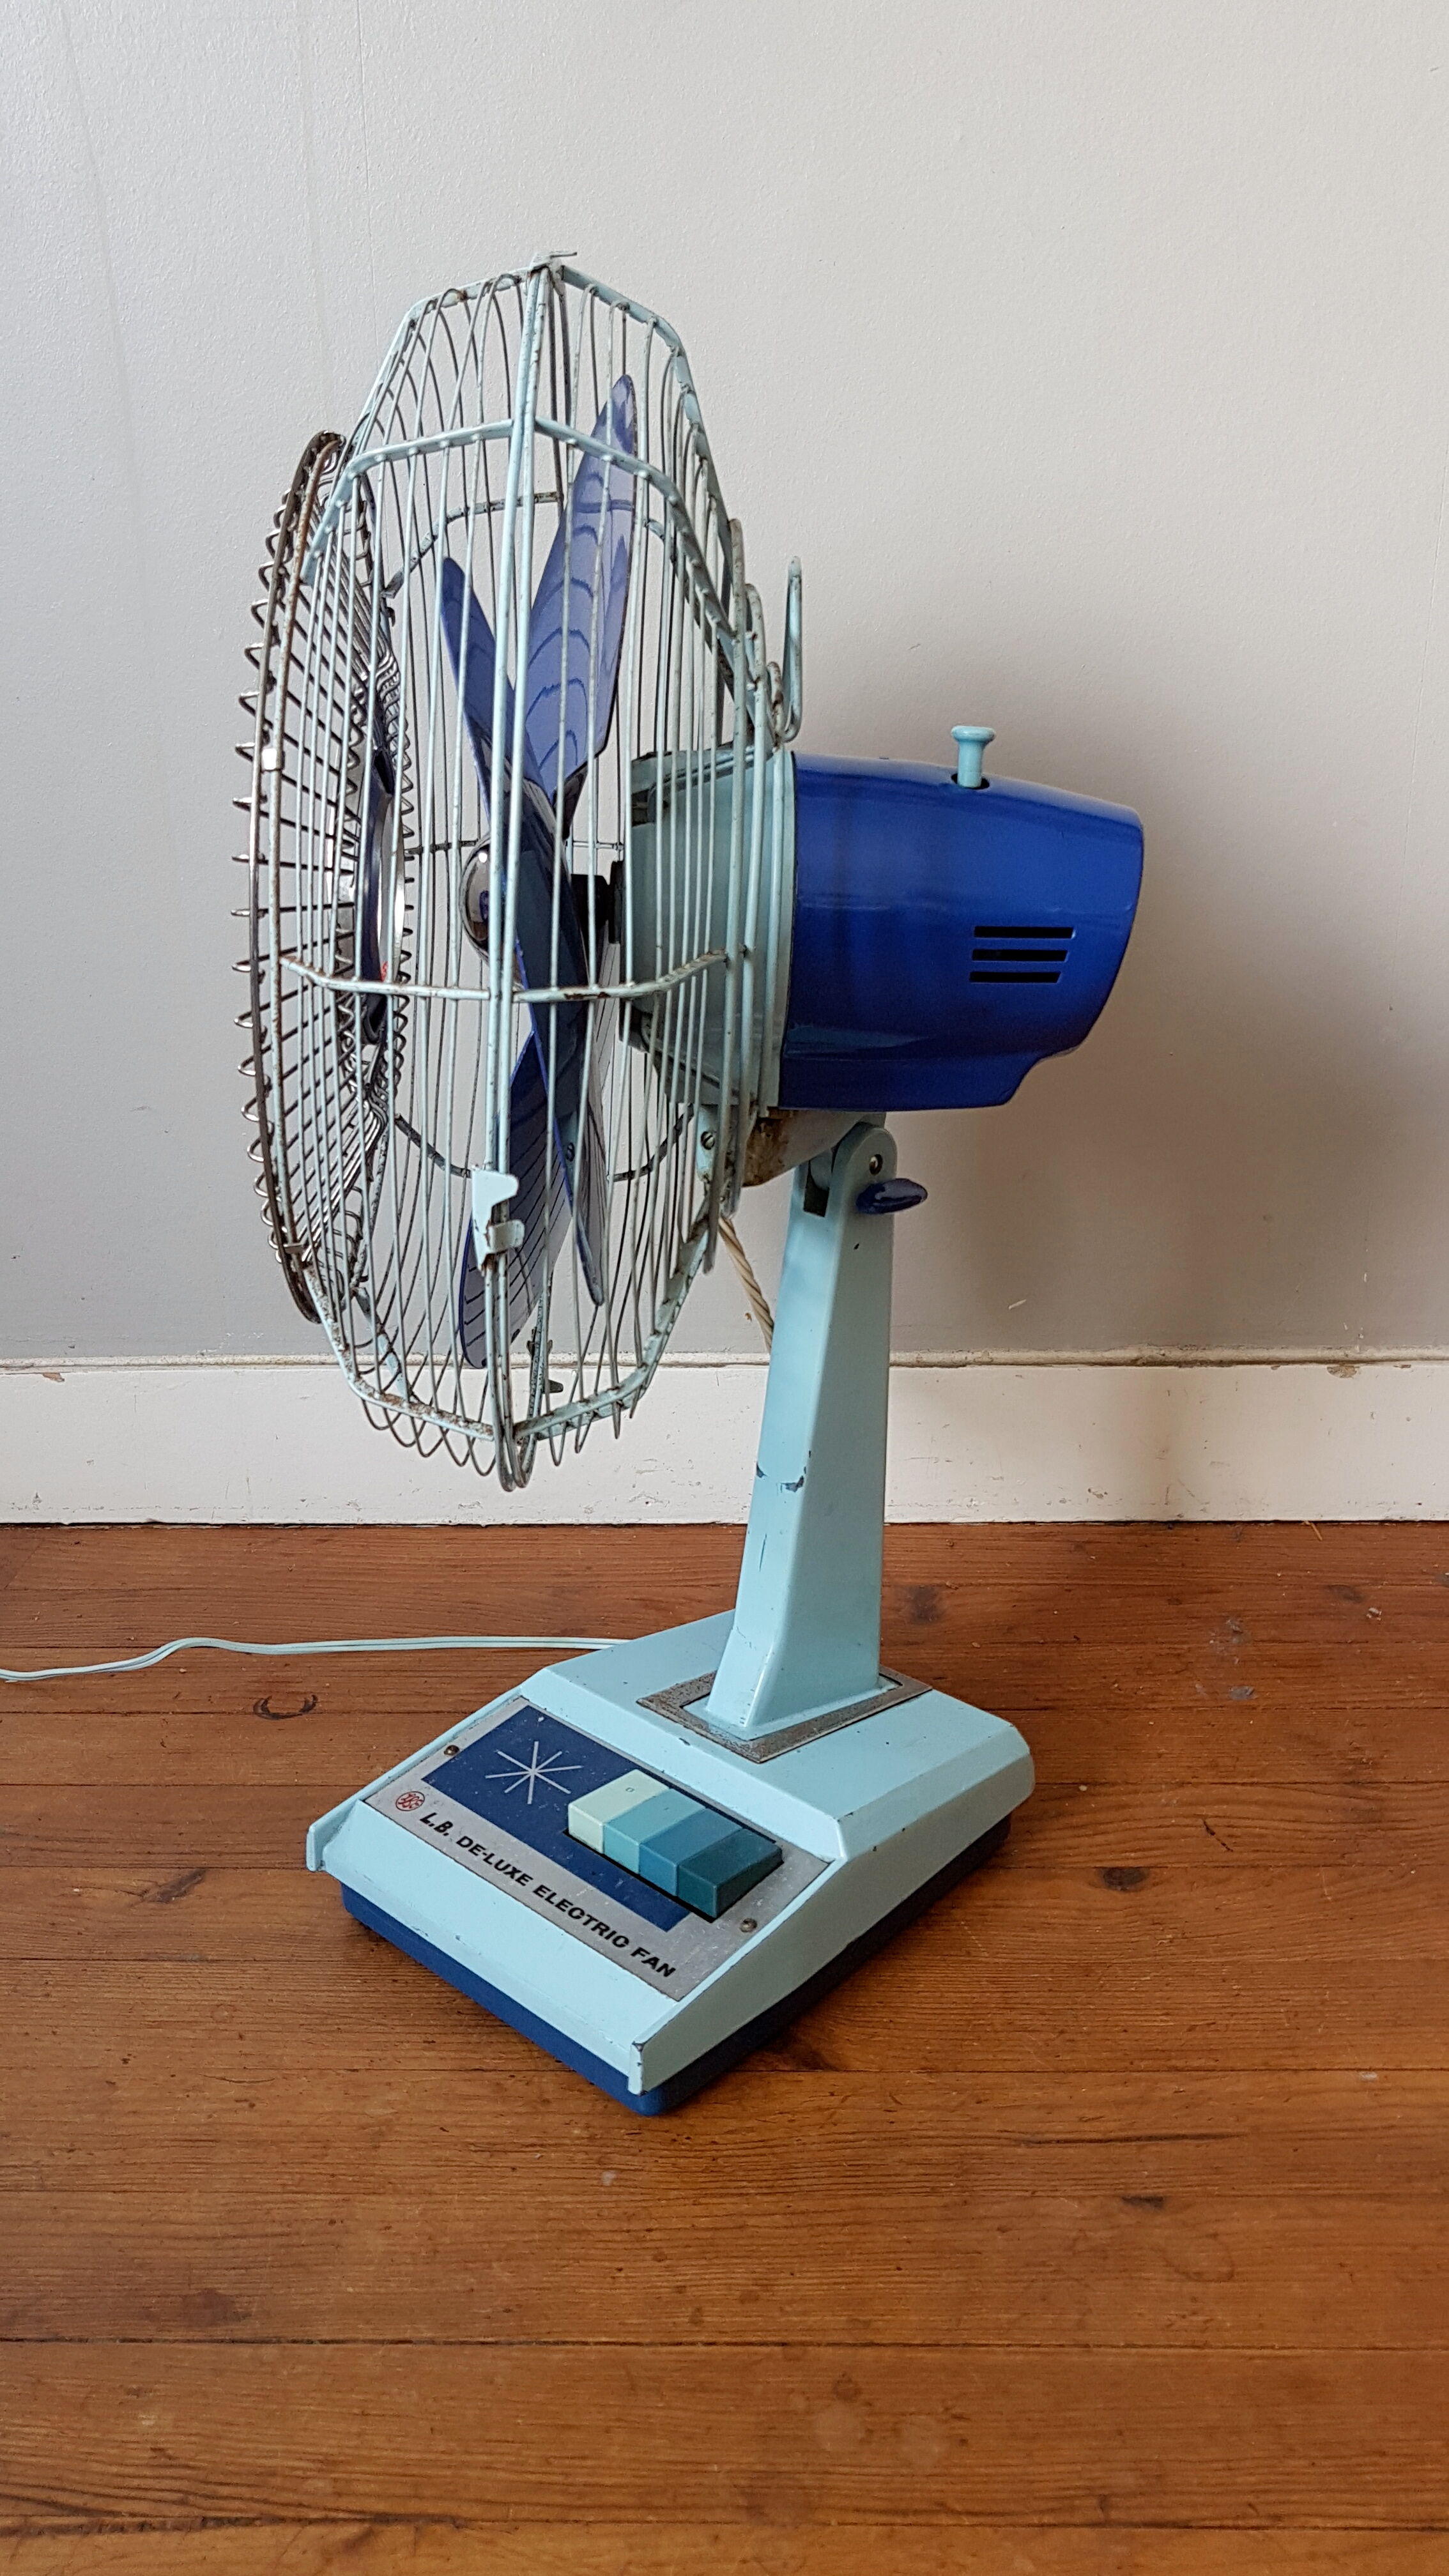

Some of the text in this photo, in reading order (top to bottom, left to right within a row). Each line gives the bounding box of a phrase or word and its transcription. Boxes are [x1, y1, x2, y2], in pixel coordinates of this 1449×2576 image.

[419, 1812, 676, 1977] L.B. DE-LUXE ELECTRIC FAN
